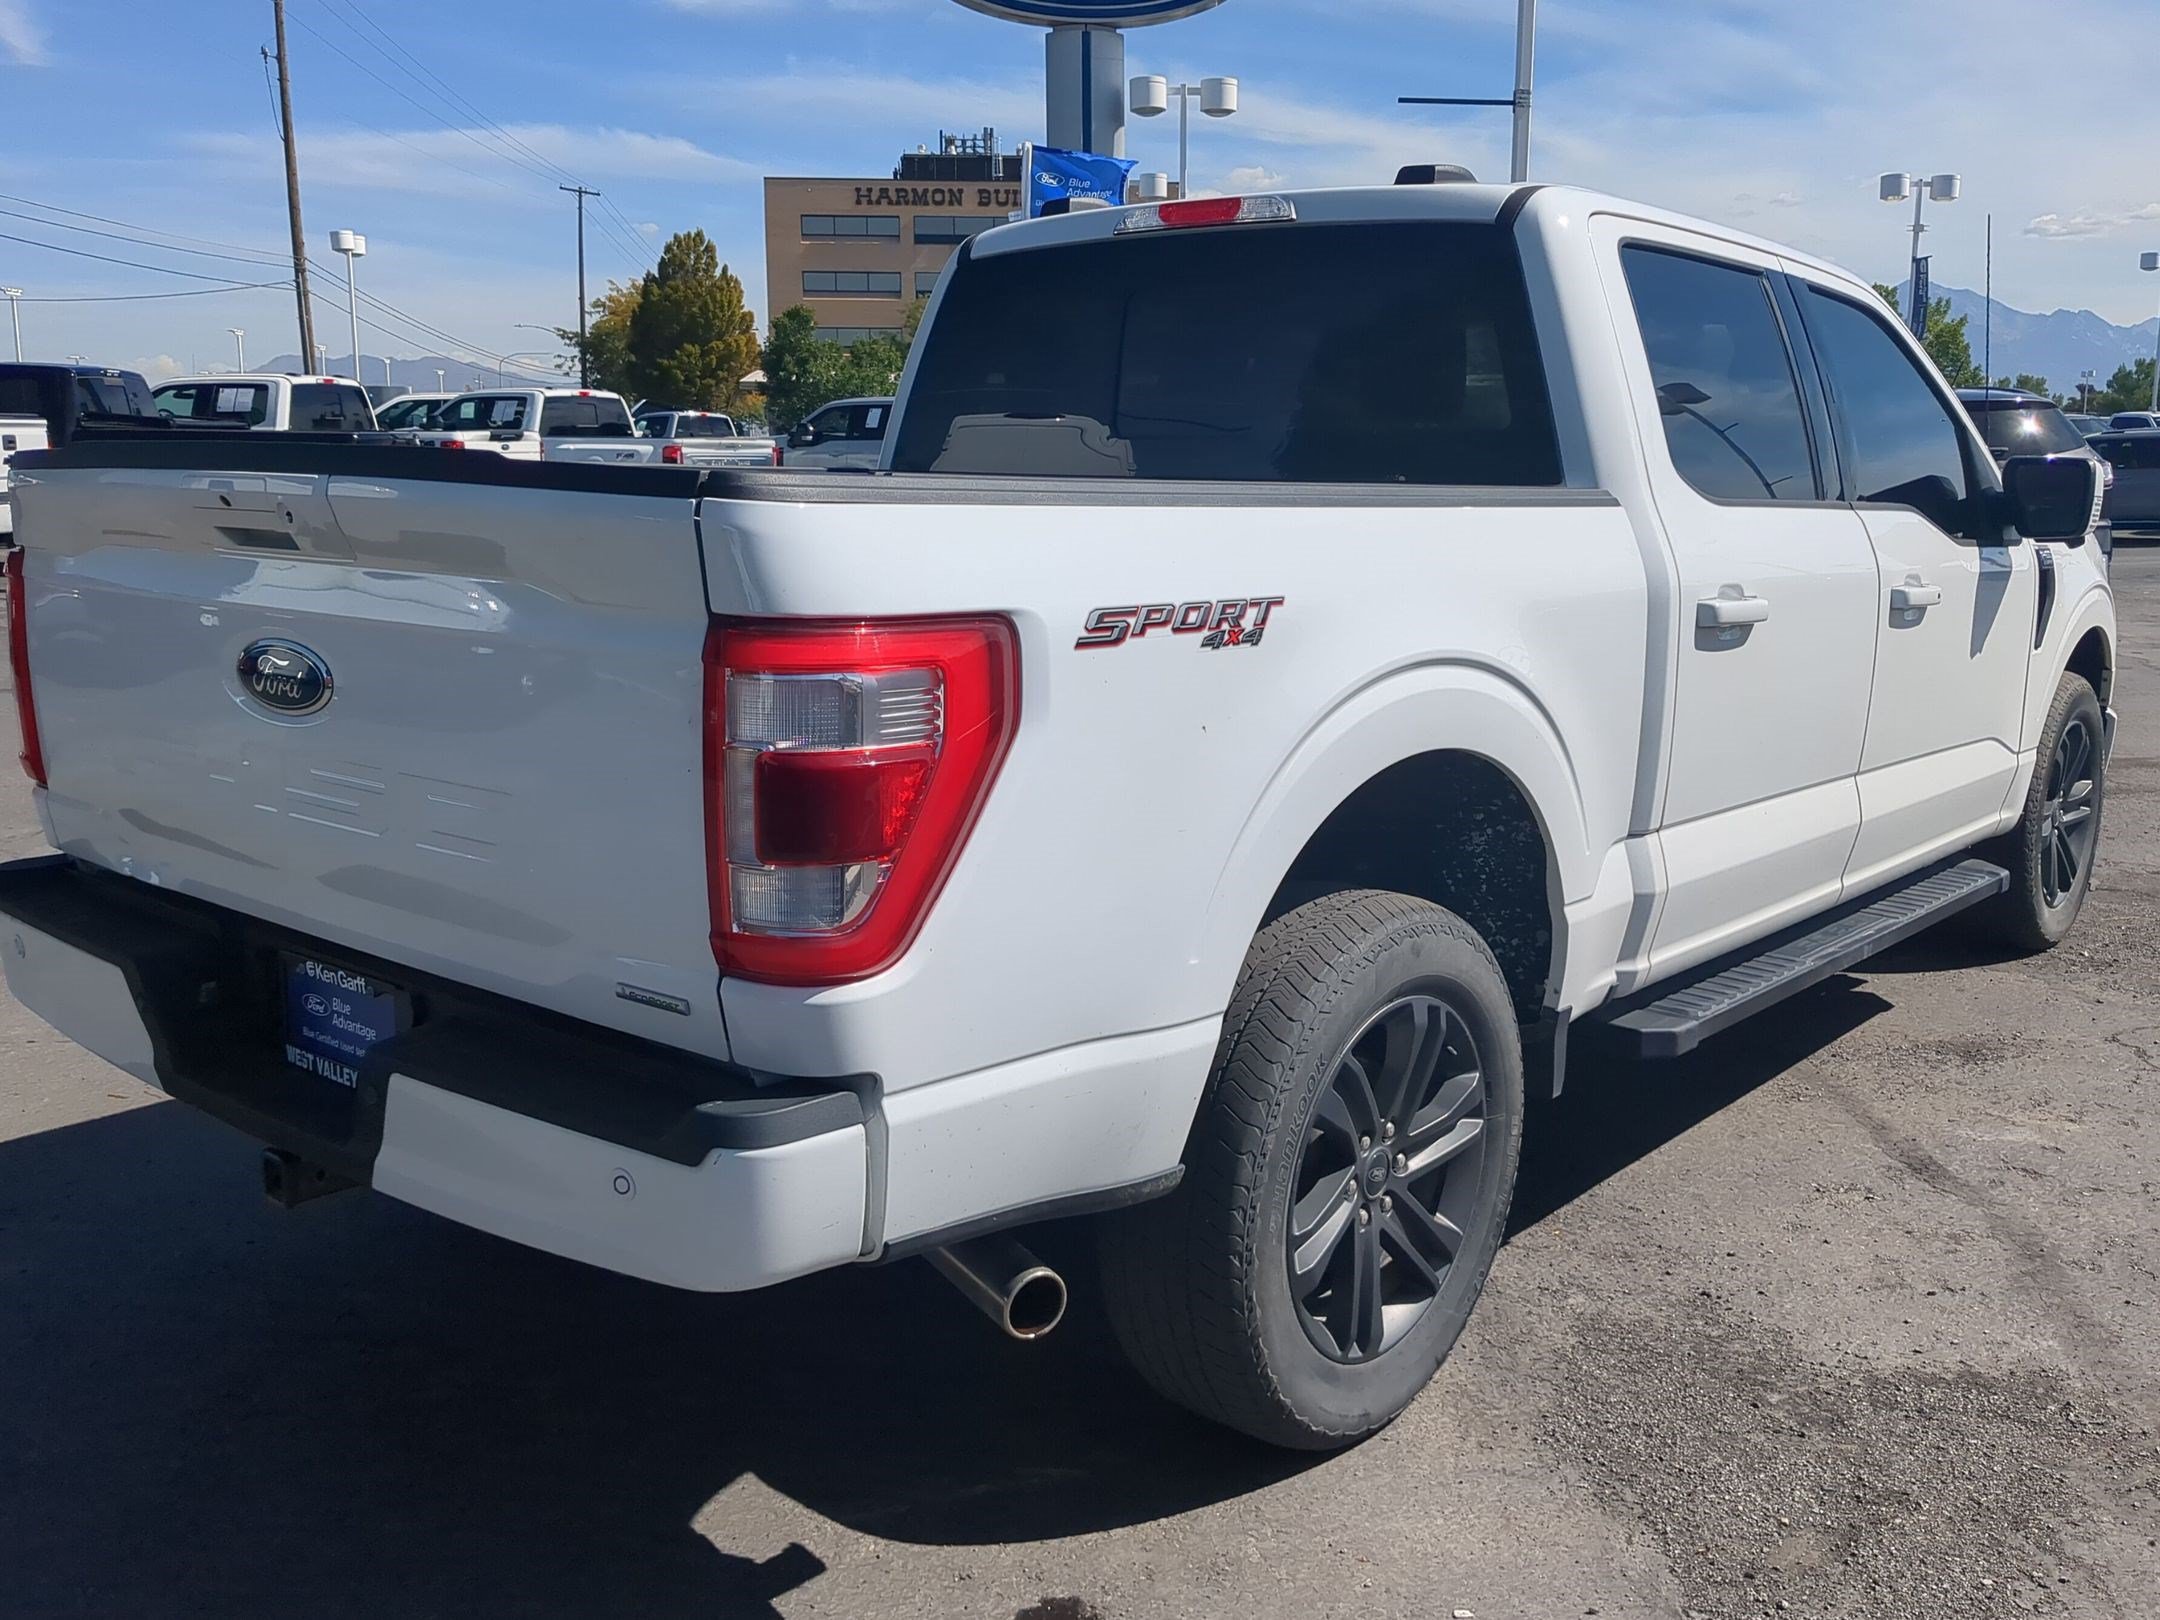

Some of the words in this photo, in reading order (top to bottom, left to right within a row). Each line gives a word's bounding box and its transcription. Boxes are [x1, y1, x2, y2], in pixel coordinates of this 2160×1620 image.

[855, 187, 964, 207] HARMON
[977, 188, 1022, 207] BUI
[1068, 178, 1091, 188] Blue
[1074, 596, 1285, 650] SPORT
[252, 654, 304, 698] Ford
[315, 962, 338, 985] Ken
[337, 970, 367, 995] Garff
[307, 996, 326, 1013] Ford
[332, 997, 352, 1015] Blue
[331, 1013, 377, 1041] Advantage
[286, 1044, 315, 1071] WEST
[316, 1055, 360, 1089] VALLEY
